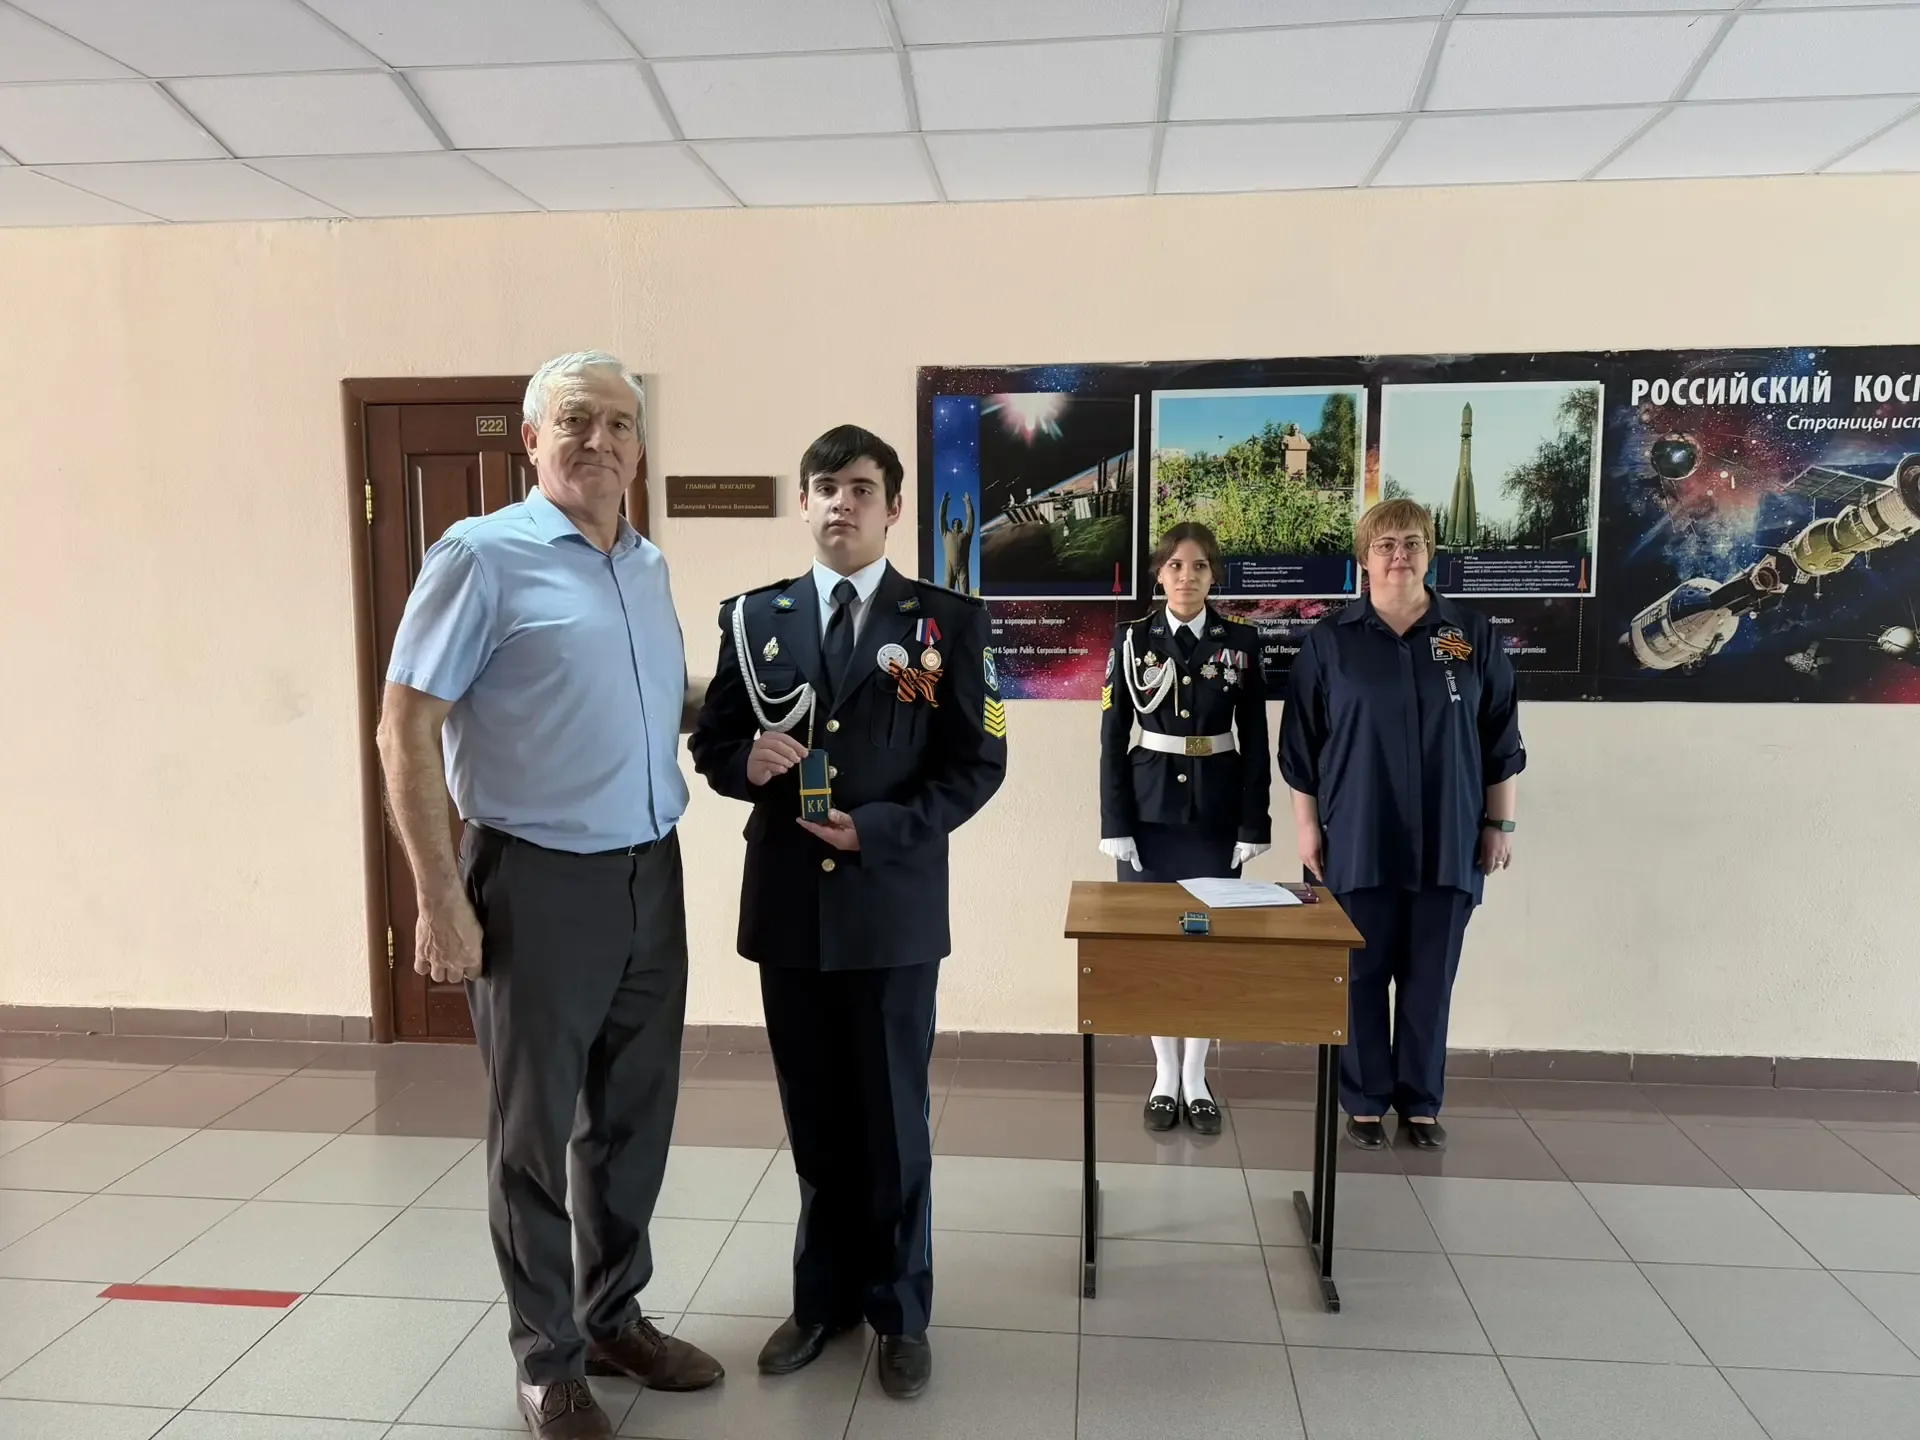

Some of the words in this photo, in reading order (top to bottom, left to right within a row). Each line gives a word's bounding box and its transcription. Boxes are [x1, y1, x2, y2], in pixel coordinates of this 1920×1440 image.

[1631, 370, 1832, 406] РОССИЙСКИЙ
[480, 419, 504, 432] 222
[1787, 415, 1888, 432] Страницы
[1003, 646, 1018, 655] Space
[1019, 646, 1035, 654] Public
[1036, 646, 1067, 655] Corporation
[1264, 645, 1279, 654] Chief
